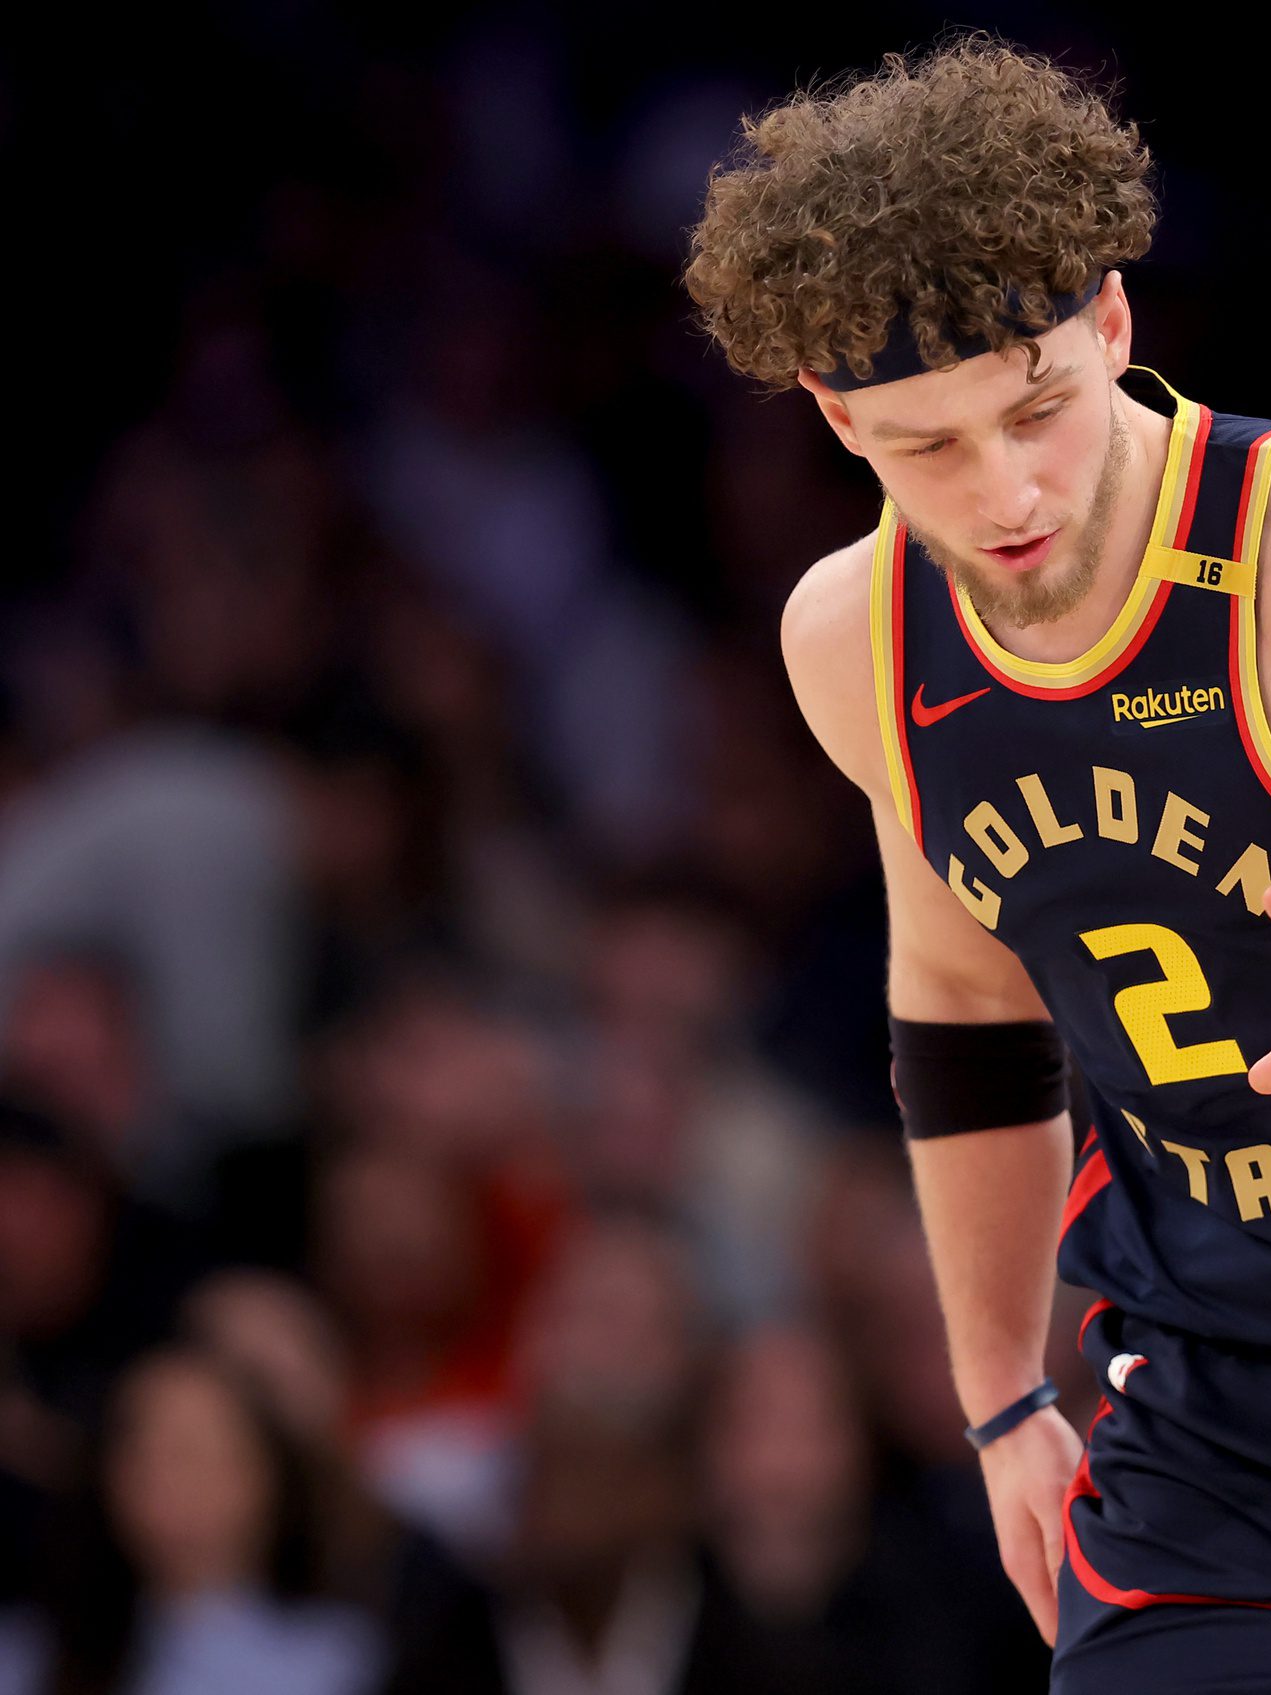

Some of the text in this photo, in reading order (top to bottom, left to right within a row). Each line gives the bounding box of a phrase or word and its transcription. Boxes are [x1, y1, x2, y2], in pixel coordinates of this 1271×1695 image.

[1196, 560, 1223, 586] 16
[1111, 685, 1225, 722] Rakuten
[1078, 923, 1249, 1087] 2
